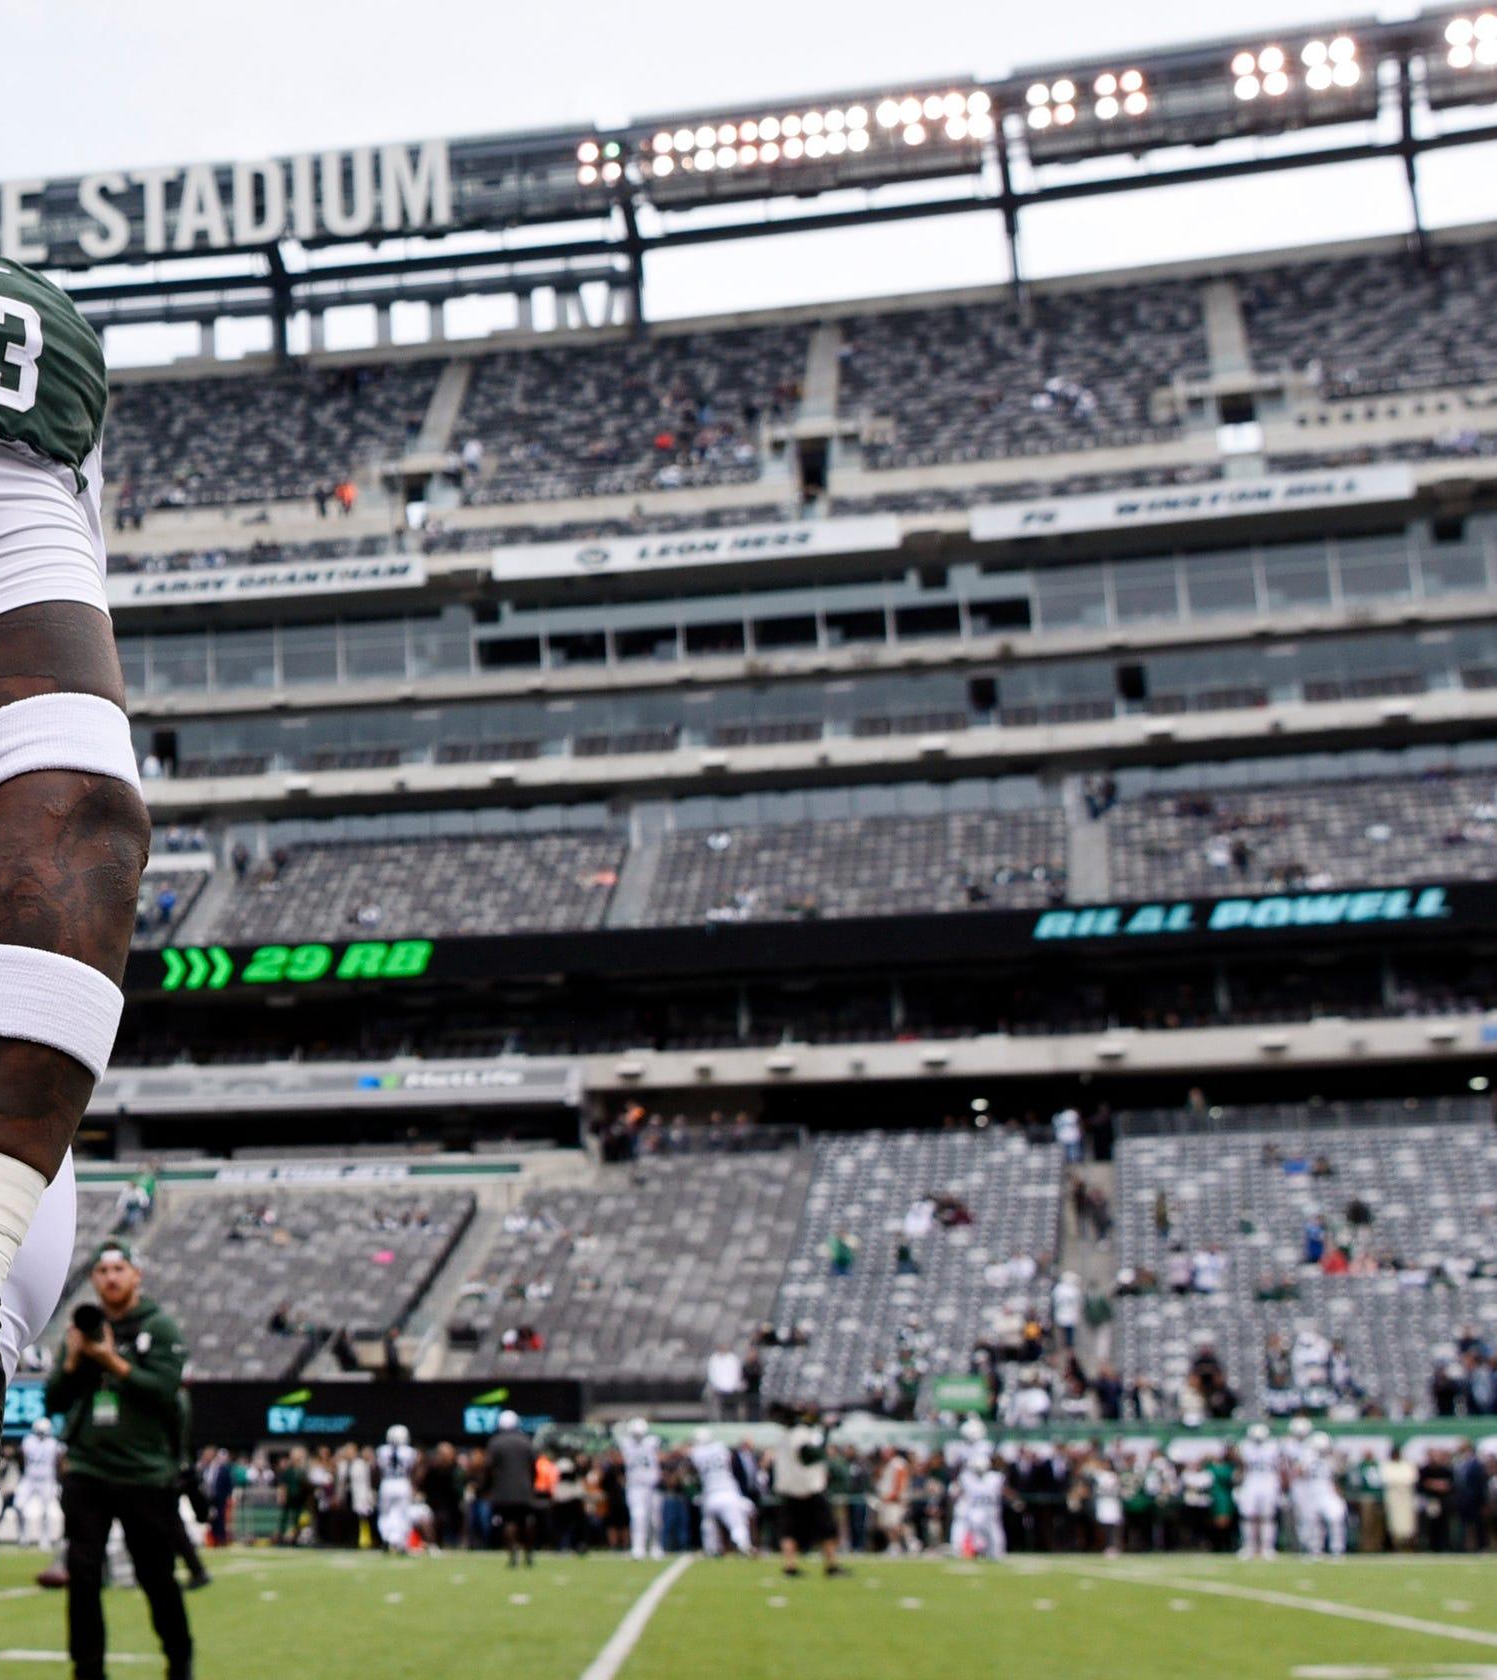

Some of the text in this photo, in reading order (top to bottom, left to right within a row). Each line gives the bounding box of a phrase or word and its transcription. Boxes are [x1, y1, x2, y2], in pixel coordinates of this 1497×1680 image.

[77, 138, 451, 259] STADIUM
[635, 540, 719, 560] LEON
[133, 564, 411, 596] LARRY GRANTHAM
[1033, 886, 1449, 940] BILAL POWELL
[241, 939, 434, 983] 29 RB
[268, 1407, 303, 1433] EY
